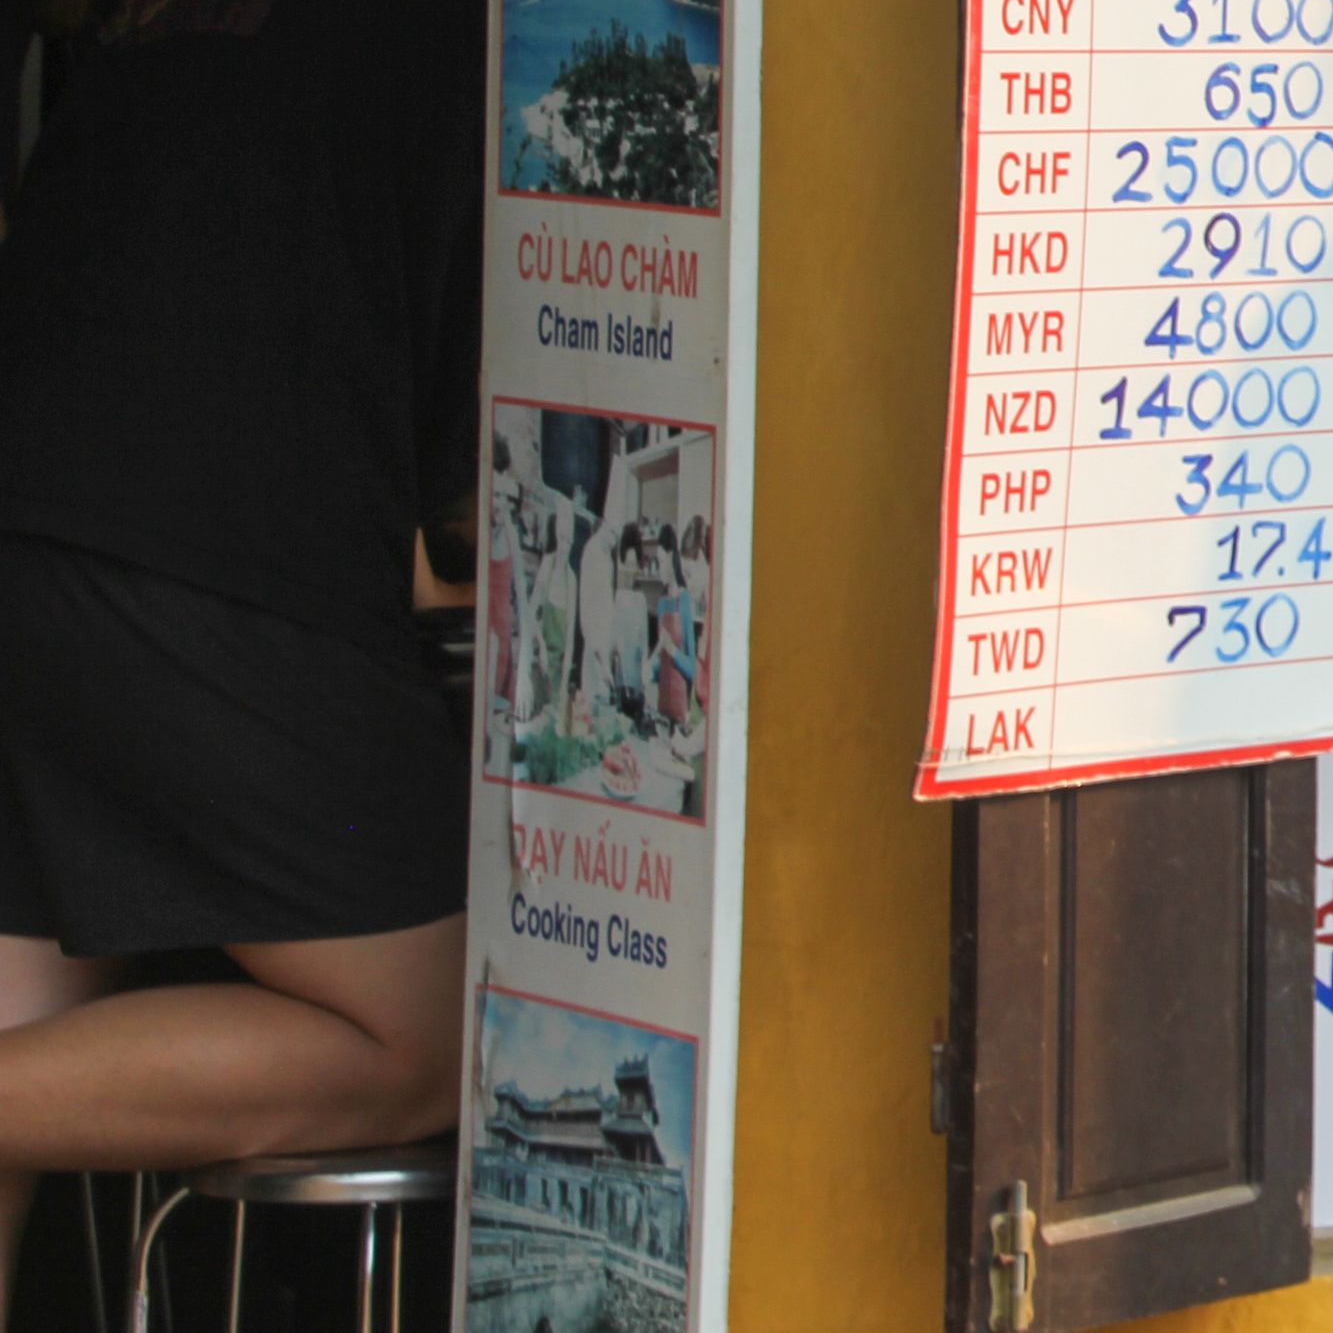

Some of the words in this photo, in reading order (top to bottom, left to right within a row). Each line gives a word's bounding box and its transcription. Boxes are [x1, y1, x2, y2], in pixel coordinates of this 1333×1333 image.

[1000, 72, 1073, 115] THB
[1204, 61, 1323, 128] 650
[998, 151, 1072, 196] CHF
[517, 221, 554, 282] CÙ
[561, 237, 614, 290] LAO
[620, 234, 699, 299] CHÀM
[992, 231, 1068, 276] HKD
[1158, 212, 1326, 280] 2910
[537, 303, 600, 352] Cham
[606, 312, 674, 361] Island
[986, 310, 1065, 356] MYR
[1143, 290, 1318, 359] 4800
[984, 390, 1057, 436] NZD
[1098, 366, 1320, 440] 14000
[979, 469, 1052, 516] PHP
[1175, 443, 1312, 515] 340
[970, 547, 1053, 597] KRW
[1216, 516, 1332, 581] 17.4
[967, 627, 1045, 677] TWD
[1166, 593, 1299, 664] 730
[965, 706, 1036, 757] LAK
[572, 818, 629, 892] NẤU
[635, 837, 673, 903] ĂN
[510, 892, 600, 963] Cooking
[606, 914, 668, 969] Class
